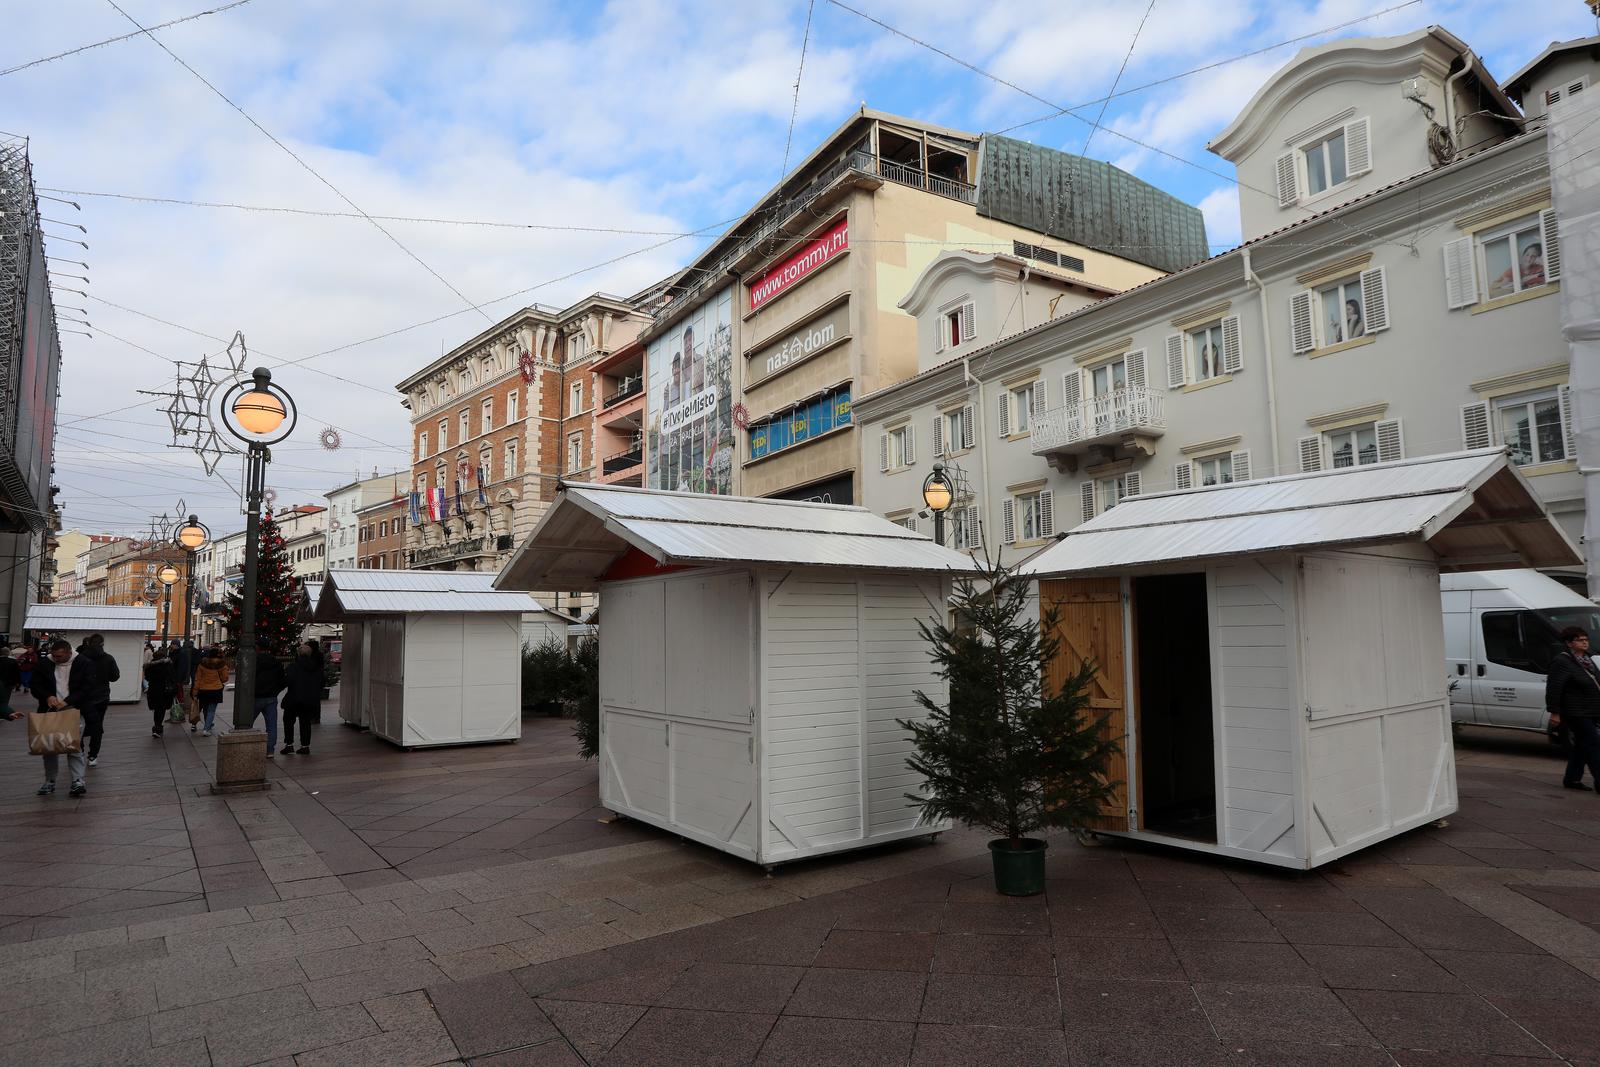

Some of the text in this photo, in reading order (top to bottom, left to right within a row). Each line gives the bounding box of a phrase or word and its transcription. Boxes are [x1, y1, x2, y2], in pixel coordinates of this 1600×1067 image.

[752, 228, 848, 304] www.tommy.hr
[767, 324, 834, 373] naš dom
[836, 401, 849, 416] TED
